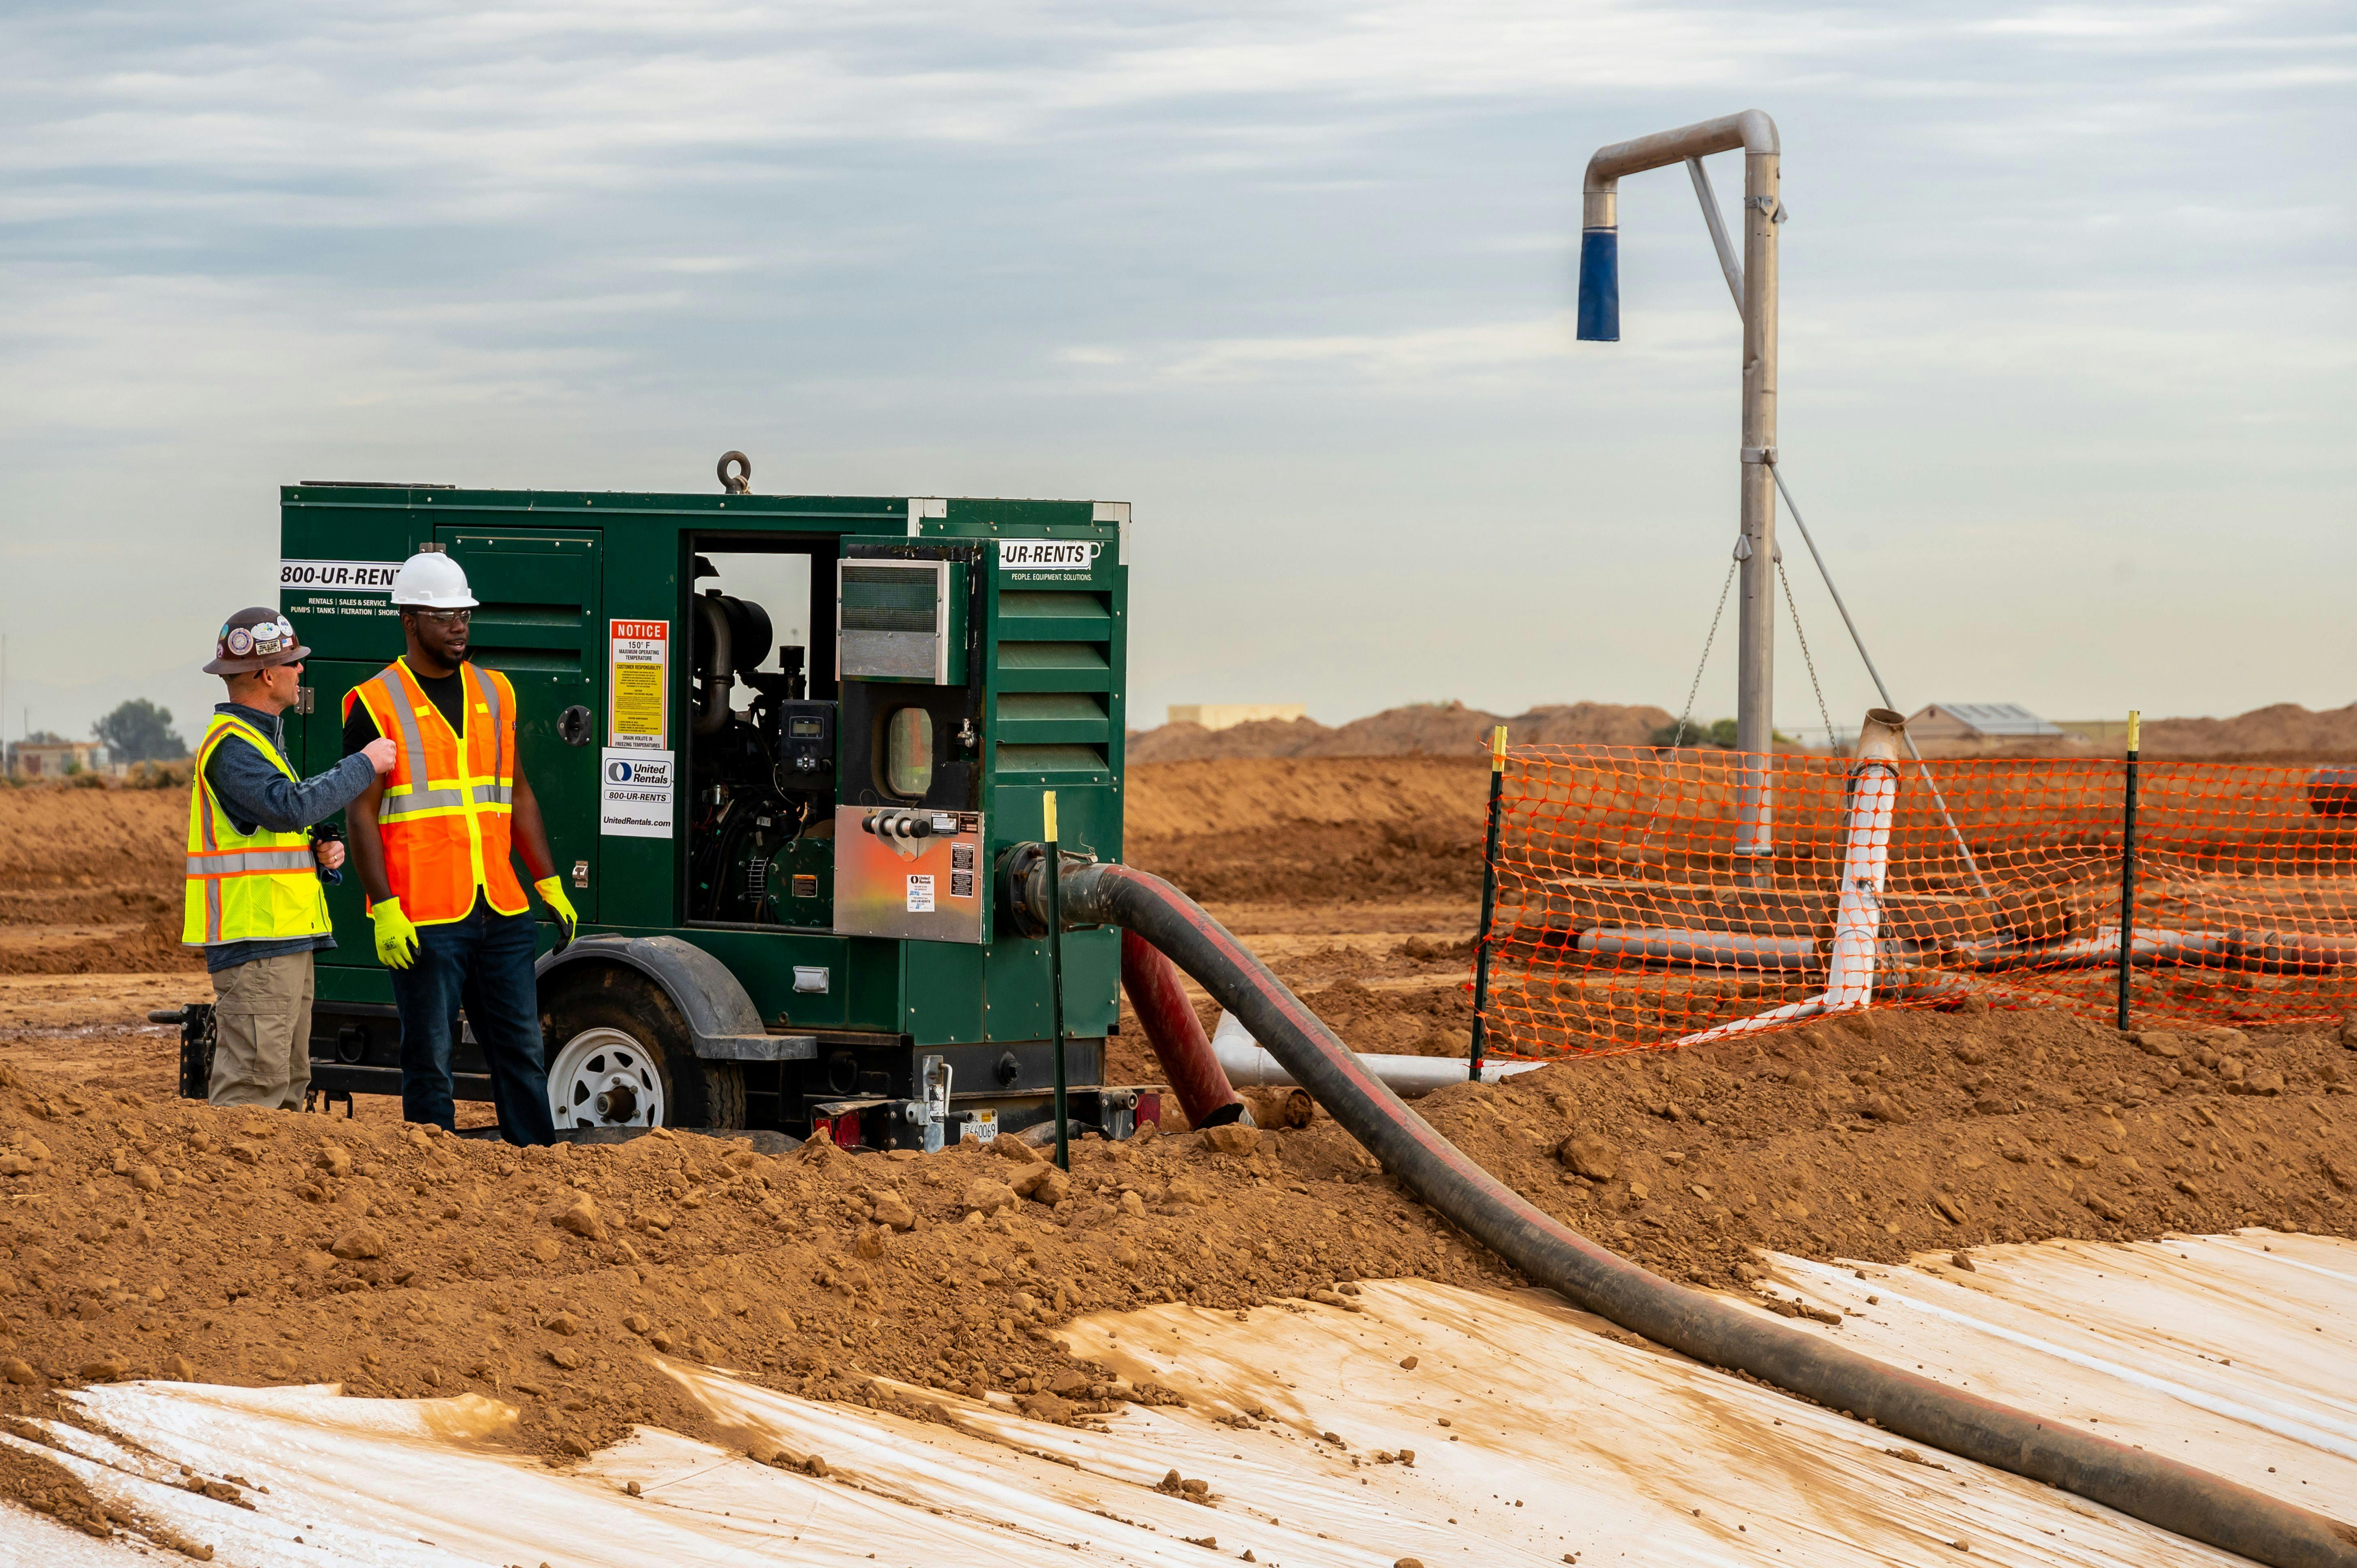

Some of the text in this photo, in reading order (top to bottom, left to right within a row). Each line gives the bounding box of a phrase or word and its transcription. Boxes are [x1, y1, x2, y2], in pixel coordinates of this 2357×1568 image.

[999, 545, 1084, 562] -UR-RENTS
[281, 566, 401, 586] 800-UR-REN
[618, 624, 661, 637] NOTICE
[634, 763, 666, 774] United
[633, 773, 668, 784] Rentals
[609, 792, 667, 801] 800-UR-RENTS
[603, 816, 671, 827] UnitedRentals.com
[970, 1124, 995, 1138] 660069
